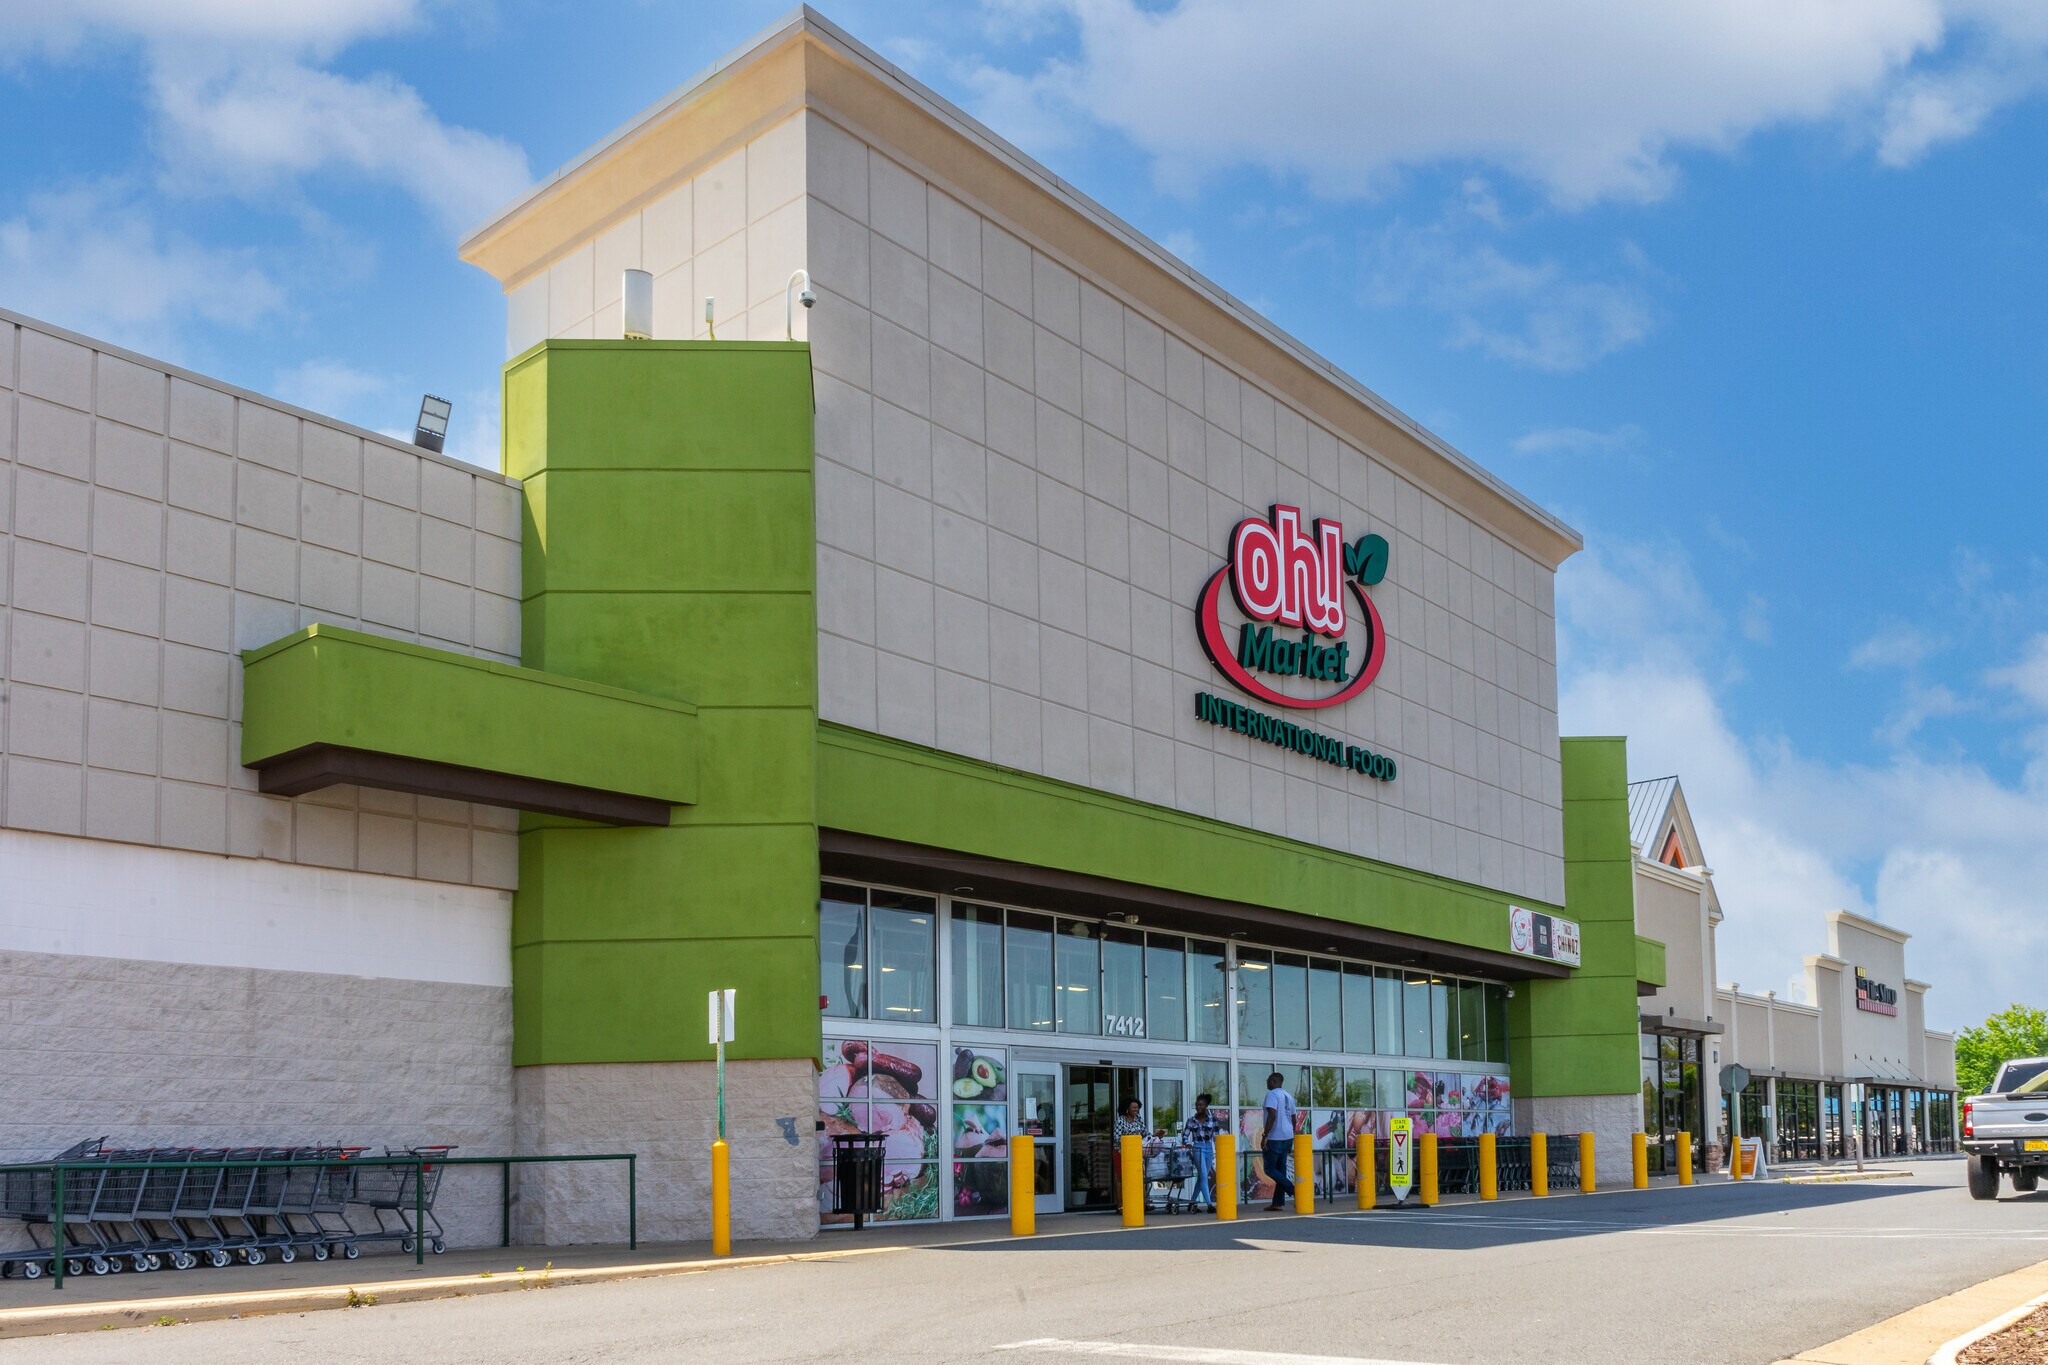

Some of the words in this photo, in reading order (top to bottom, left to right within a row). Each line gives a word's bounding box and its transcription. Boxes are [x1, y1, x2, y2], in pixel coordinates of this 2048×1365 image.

[1232, 504, 1346, 638] oh!
[1237, 623, 1349, 682] Market
[1197, 692, 1348, 768] INTERNATIONAL
[1347, 746, 1396, 781] FOOD
[1105, 1014, 1144, 1037] 7412
